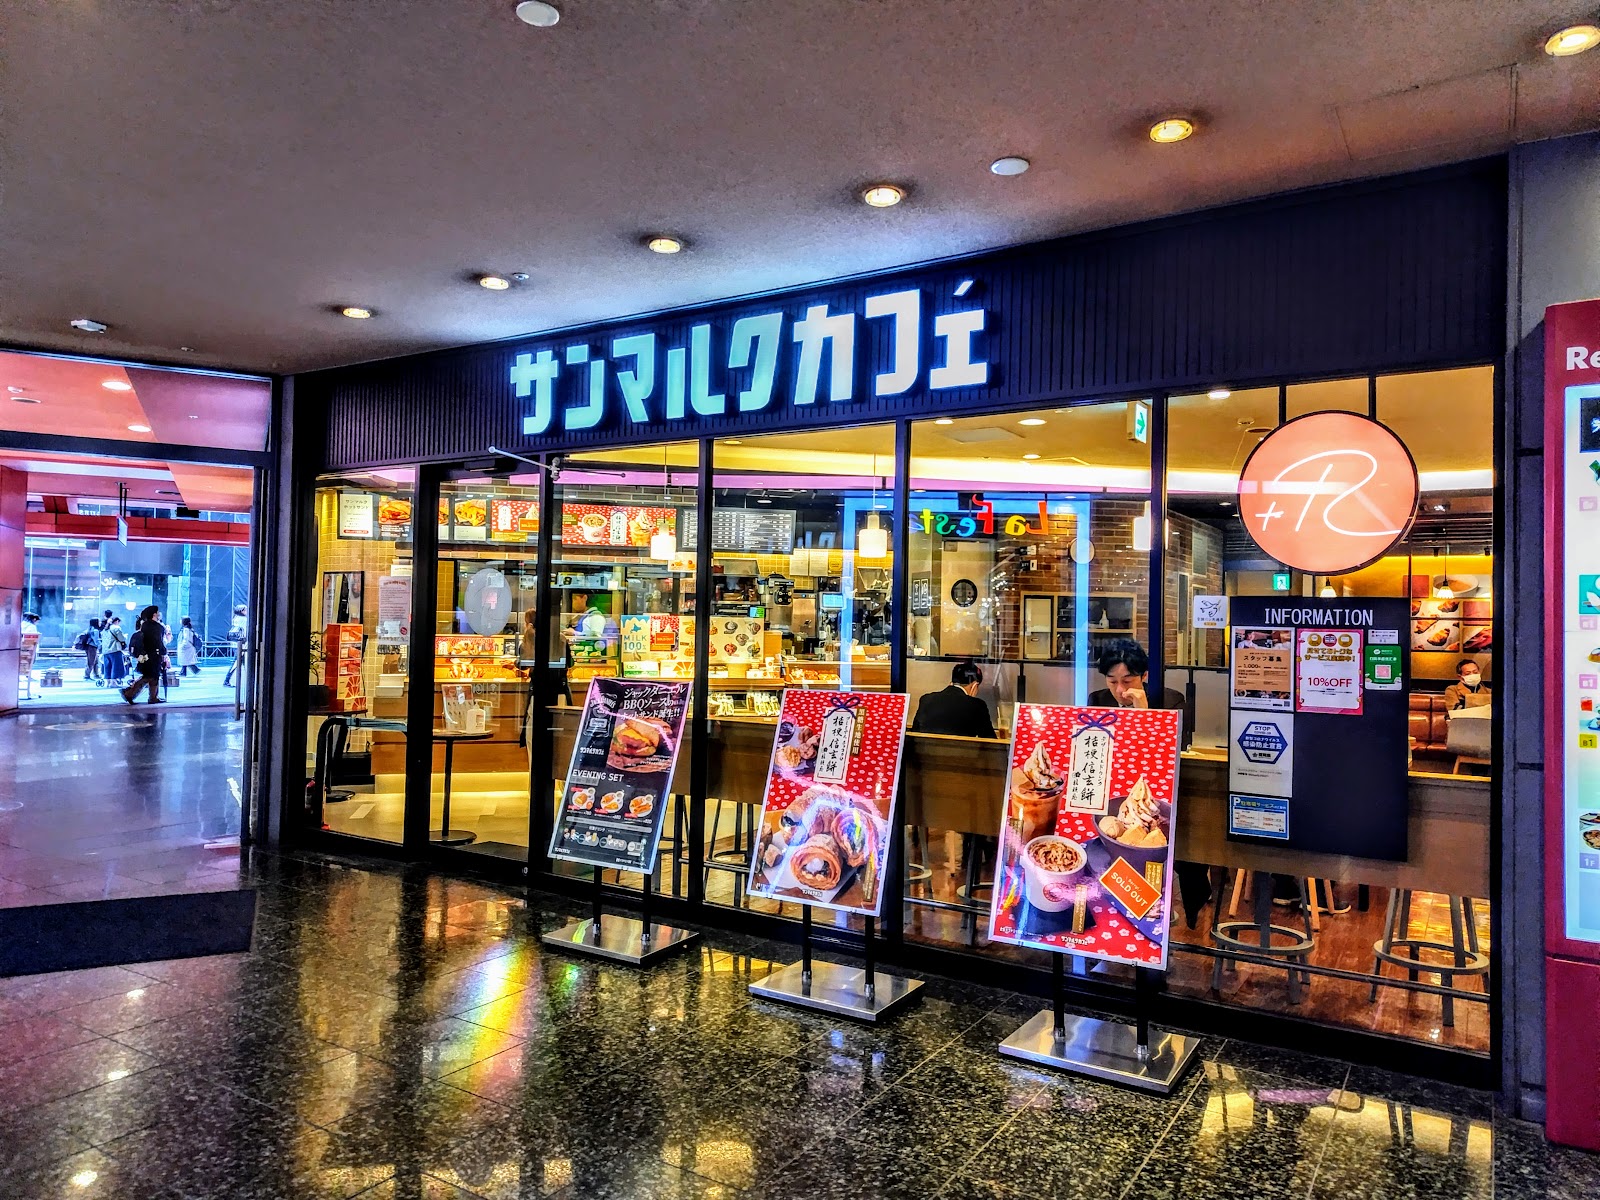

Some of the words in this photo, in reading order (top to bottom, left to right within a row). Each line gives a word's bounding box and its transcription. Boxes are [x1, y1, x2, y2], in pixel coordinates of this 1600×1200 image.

[1264, 608, 1374, 626] INFORMATION
[624, 634, 648, 642] MILK
[1243, 655, 1282, 663] スタッフ募集
[1308, 677, 1353, 688] 10%OFF
[825, 715, 844, 776] 桔梗信玄餅
[572, 768, 607, 780] EVENING
[608, 773, 625, 782] SET
[1080, 735, 1099, 806] 桔梗信玄餅
[1110, 871, 1132, 893] SOLD
[1130, 890, 1149, 907] OUT
